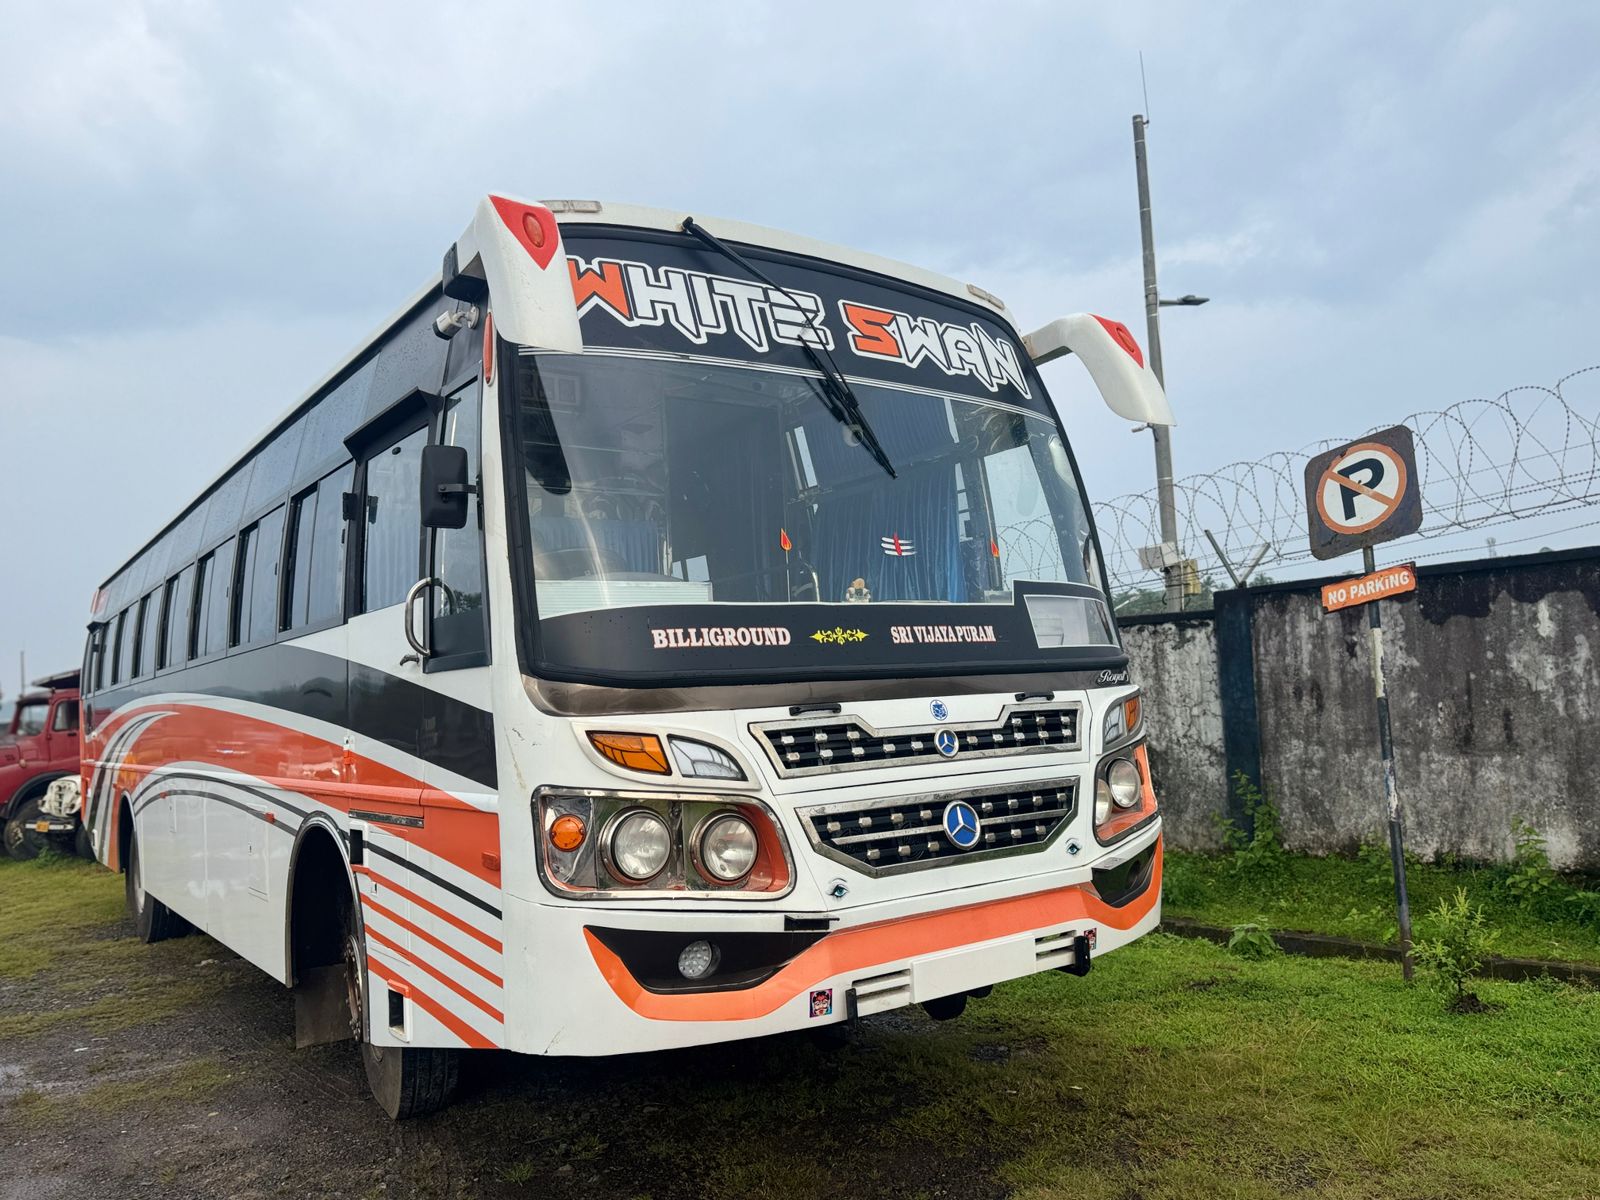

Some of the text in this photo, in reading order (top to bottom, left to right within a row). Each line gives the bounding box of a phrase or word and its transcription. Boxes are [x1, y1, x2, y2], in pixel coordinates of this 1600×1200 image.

[566, 254, 1032, 400] WHITE SWAN
[1337, 458, 1385, 521] P
[1327, 588, 1347, 606] NO
[651, 627, 792, 649] BILLIGROUND
[890, 625, 914, 644] SRI
